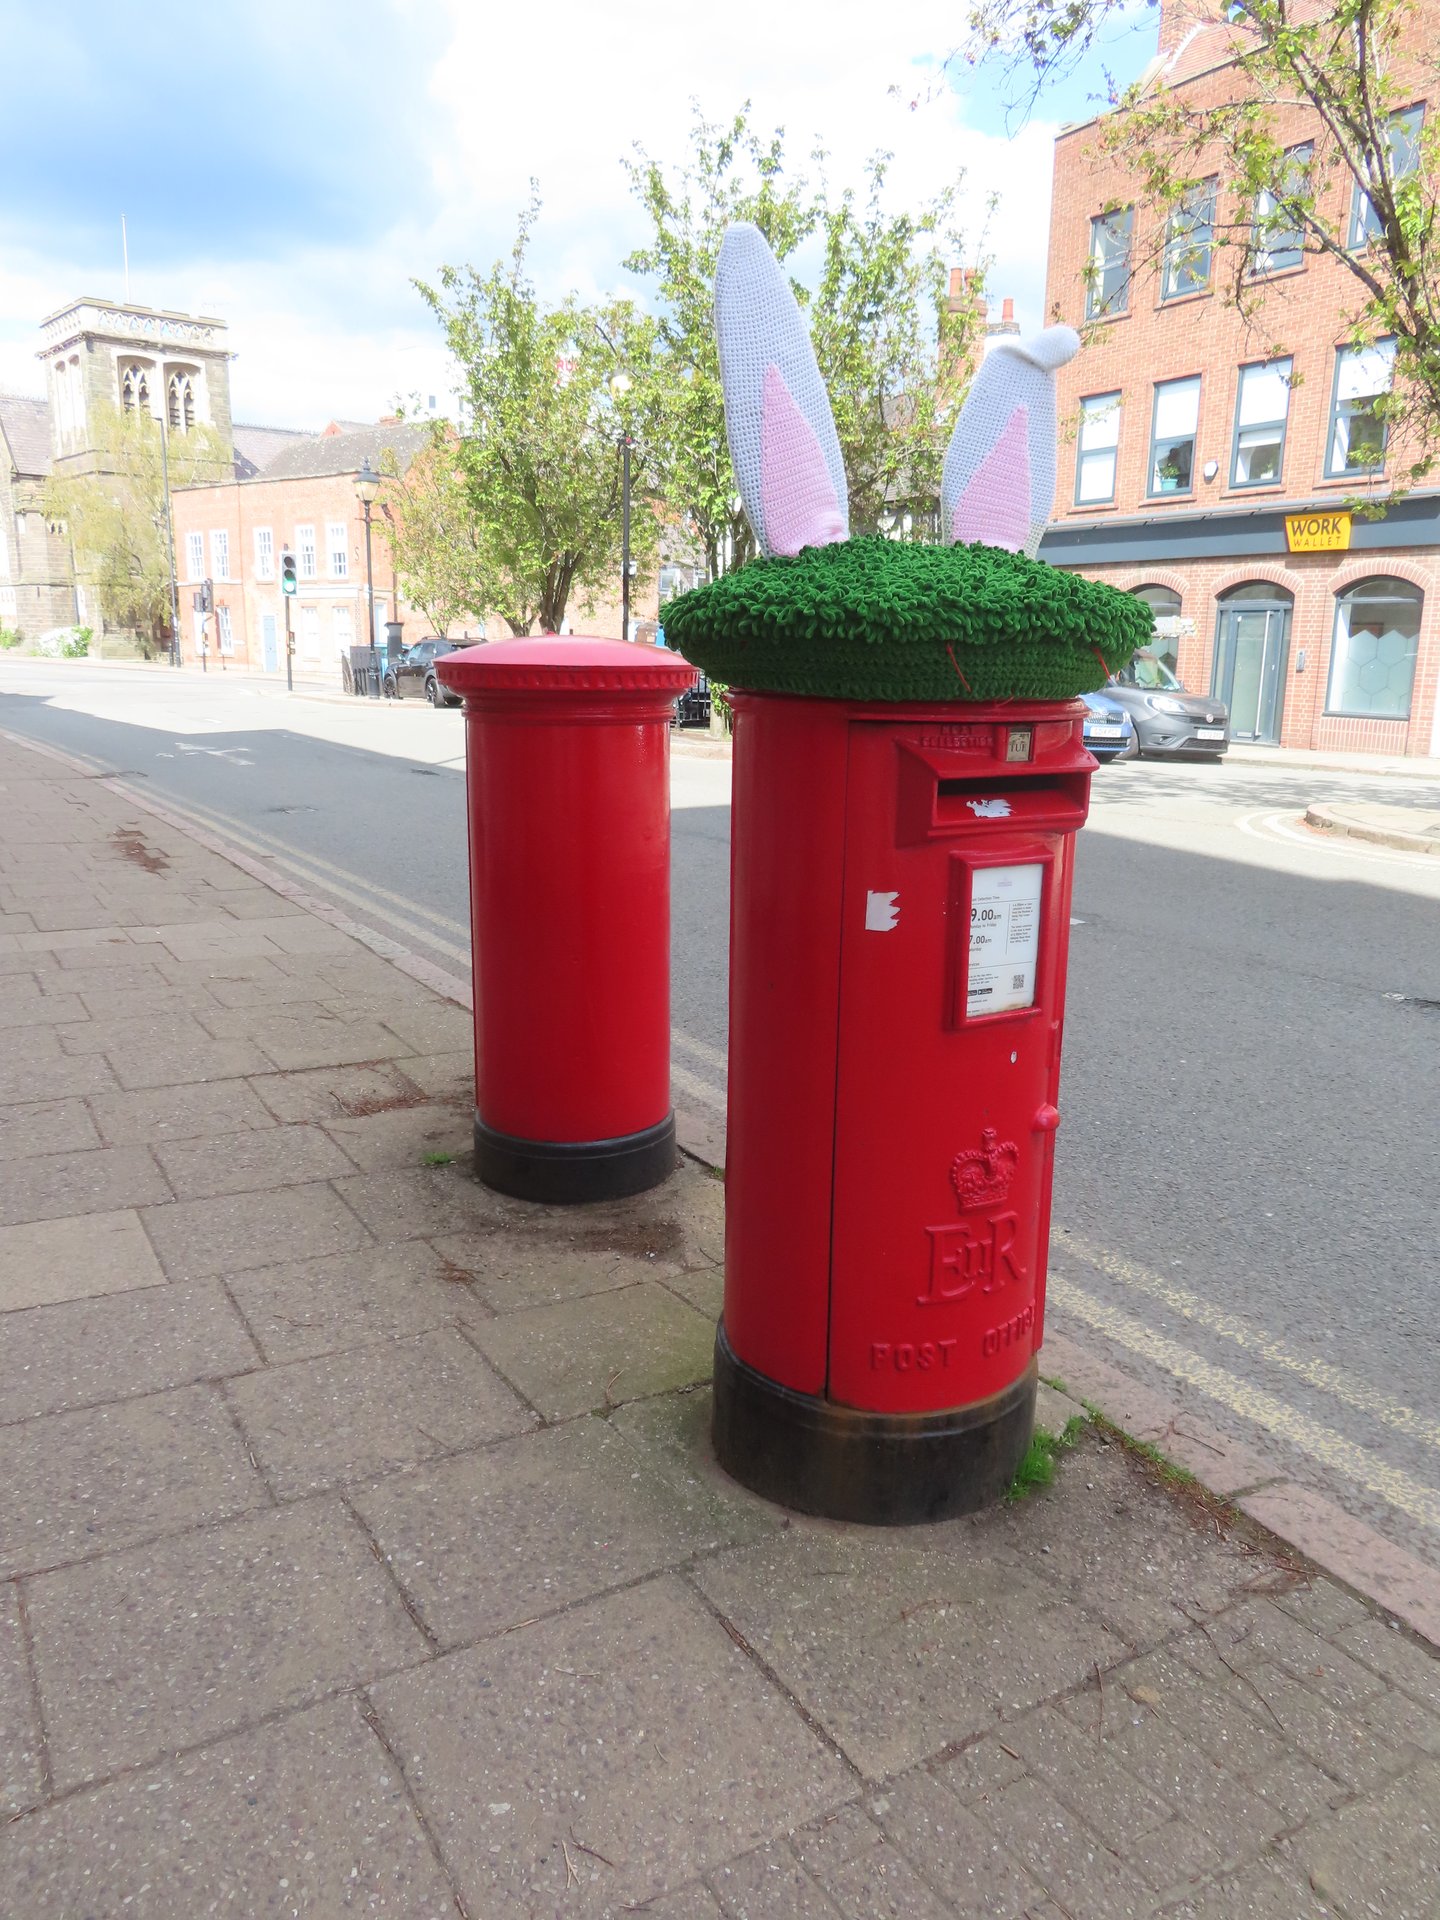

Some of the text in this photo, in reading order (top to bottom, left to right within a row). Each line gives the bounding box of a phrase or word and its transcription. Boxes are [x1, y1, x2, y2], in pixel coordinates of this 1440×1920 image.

[1291, 517, 1342, 536] WORK
[1293, 536, 1341, 547] WALLET
[921, 735, 993, 748] COLLECTION
[1009, 740, 1027, 753] TUE
[971, 908, 1002, 922] 9.00am
[870, 1298, 1035, 1371] POST OFFICE
